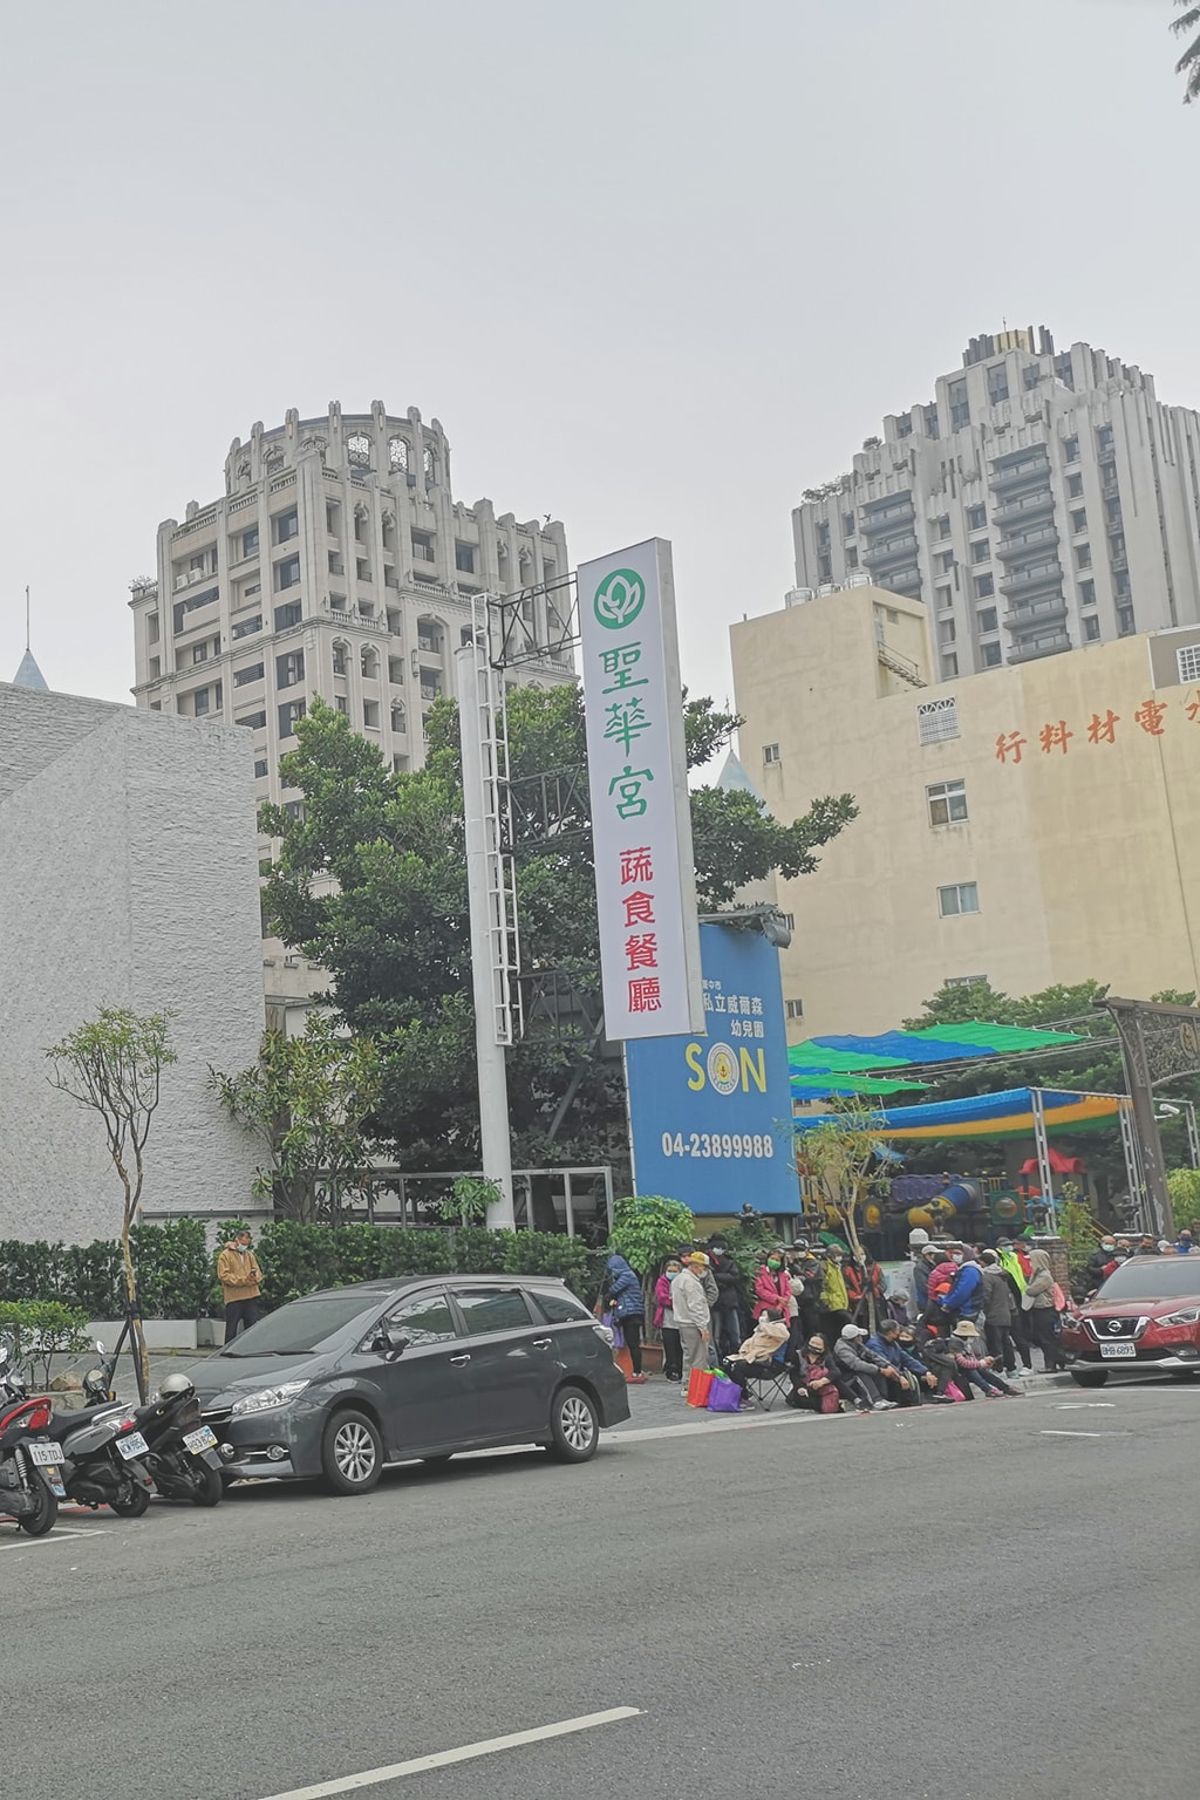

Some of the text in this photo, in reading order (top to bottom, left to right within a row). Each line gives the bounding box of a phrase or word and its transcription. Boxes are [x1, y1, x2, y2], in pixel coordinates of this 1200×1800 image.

[599, 641, 655, 820] 聖華宮
[619, 846, 662, 1013] 蔬食餐廳
[662, 1132, 773, 1158] 04-23899988
